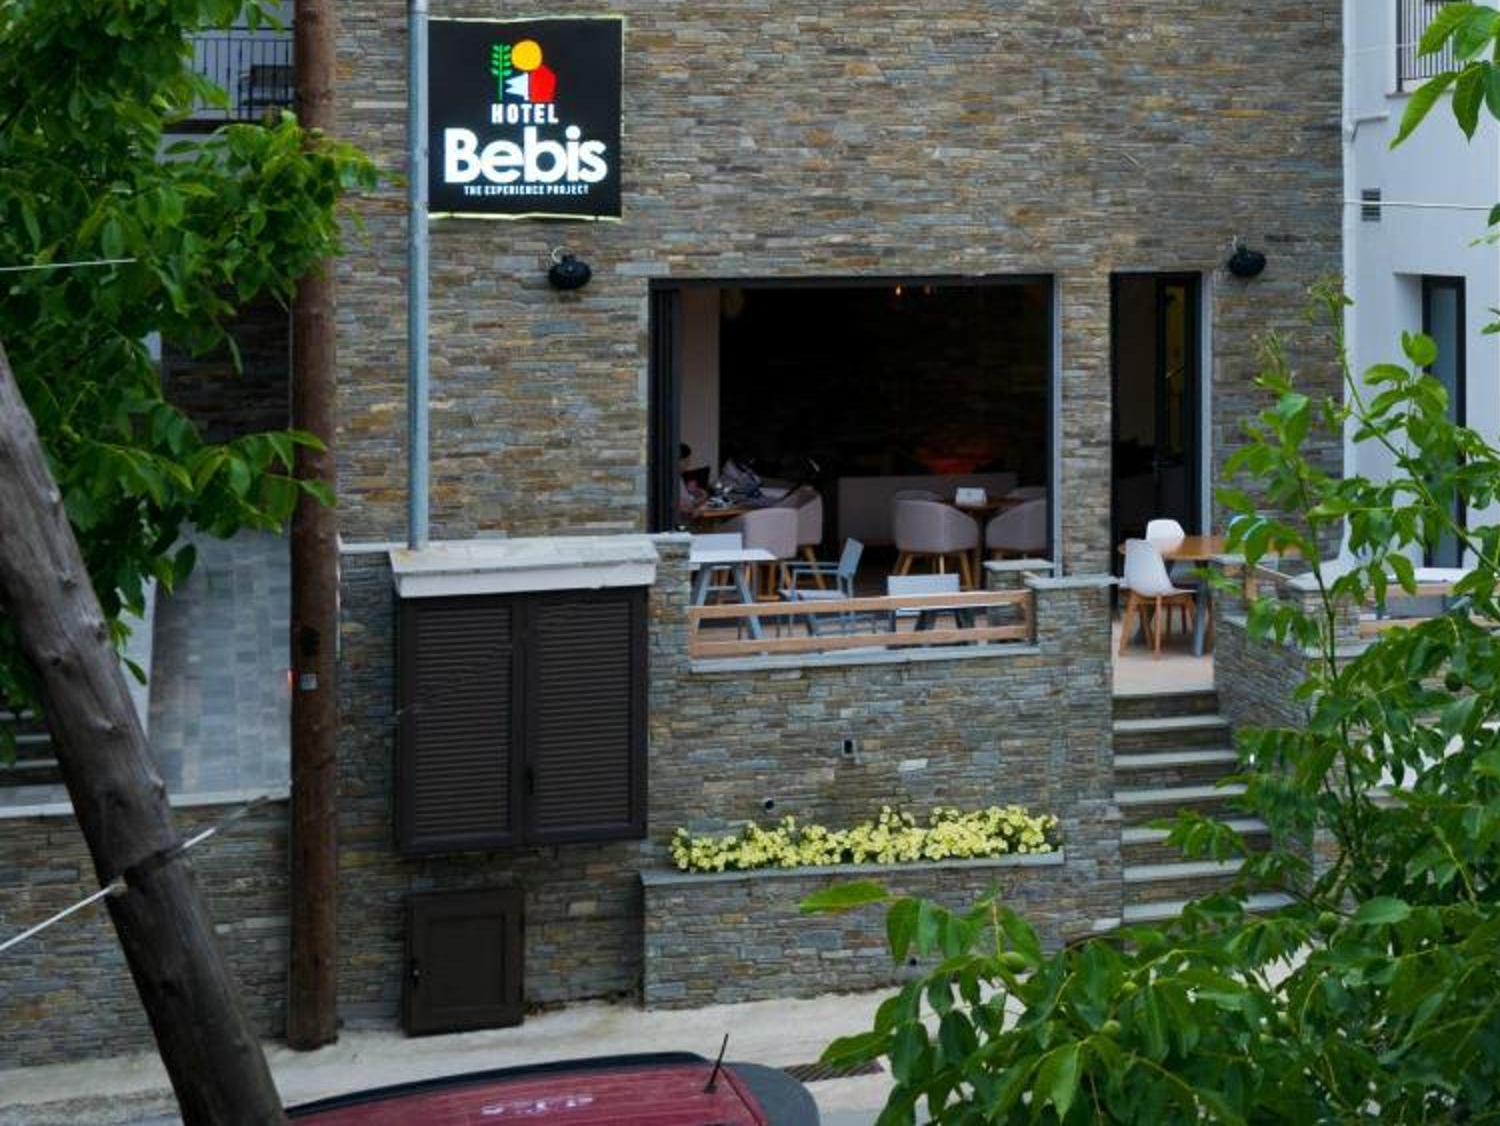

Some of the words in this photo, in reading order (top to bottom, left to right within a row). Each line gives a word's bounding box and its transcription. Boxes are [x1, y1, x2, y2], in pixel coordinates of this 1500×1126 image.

[491, 103, 558, 124] HOTEL
[444, 125, 608, 184] Bebis
[464, 185, 482, 195] THE
[484, 185, 545, 195] EXPERIENCE
[547, 185, 589, 195] PROJECT
